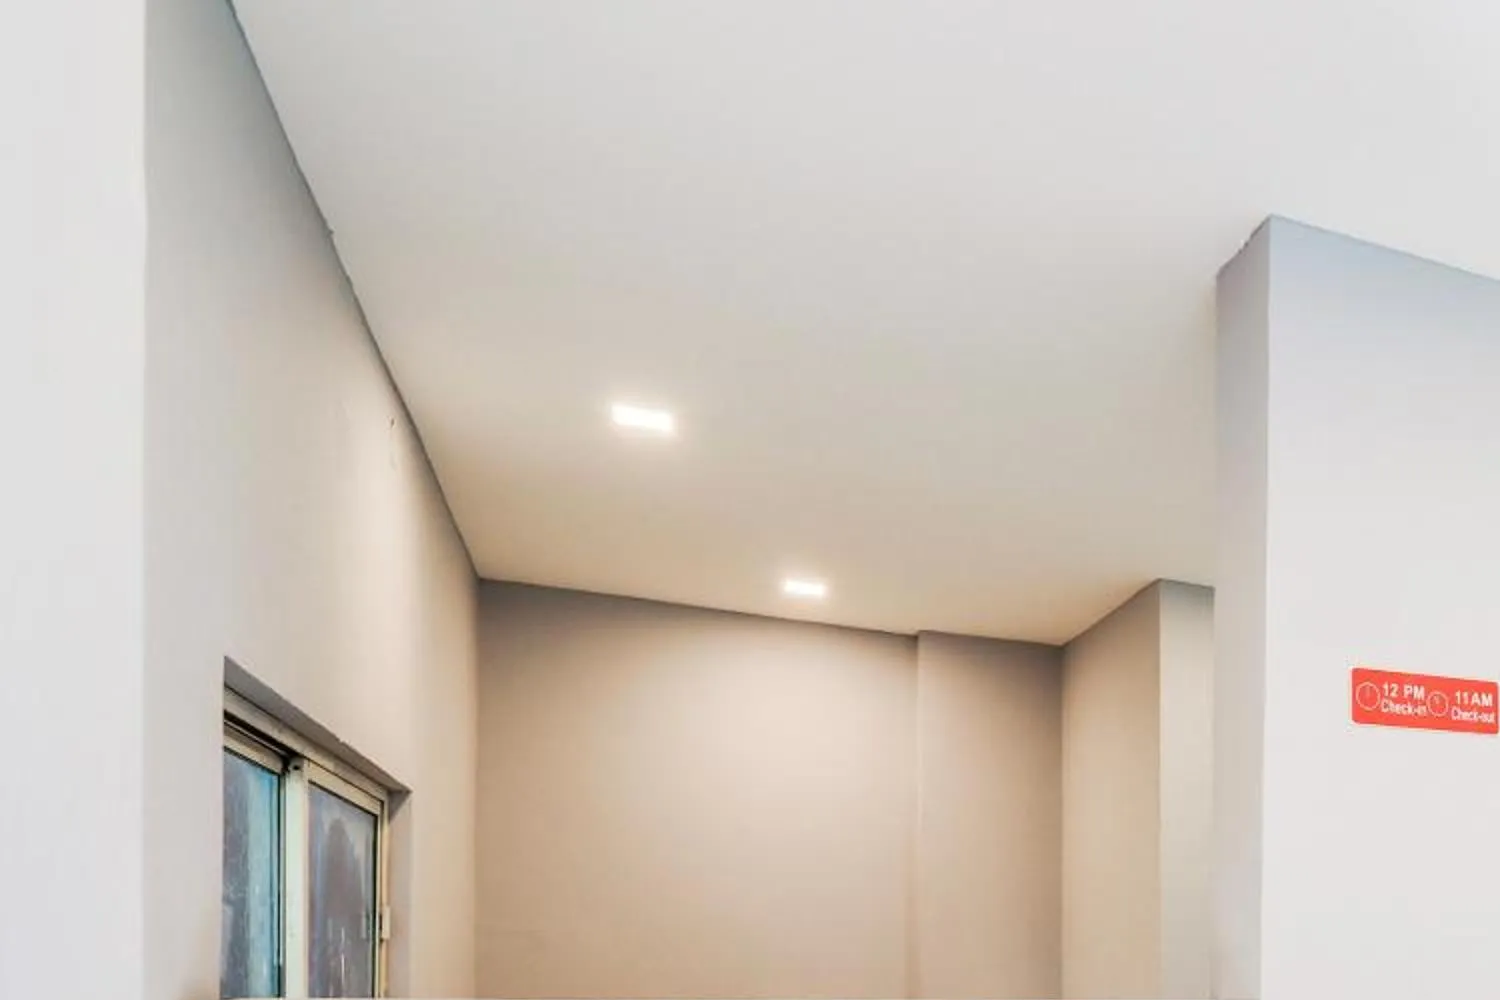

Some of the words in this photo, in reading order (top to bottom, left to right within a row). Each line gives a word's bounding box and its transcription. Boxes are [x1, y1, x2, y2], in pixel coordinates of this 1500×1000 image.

[1382, 683, 1399, 697] 12
[1403, 684, 1425, 700] PM
[1381, 699, 1427, 716] Check-in
[1451, 707, 1495, 723] Check-out
